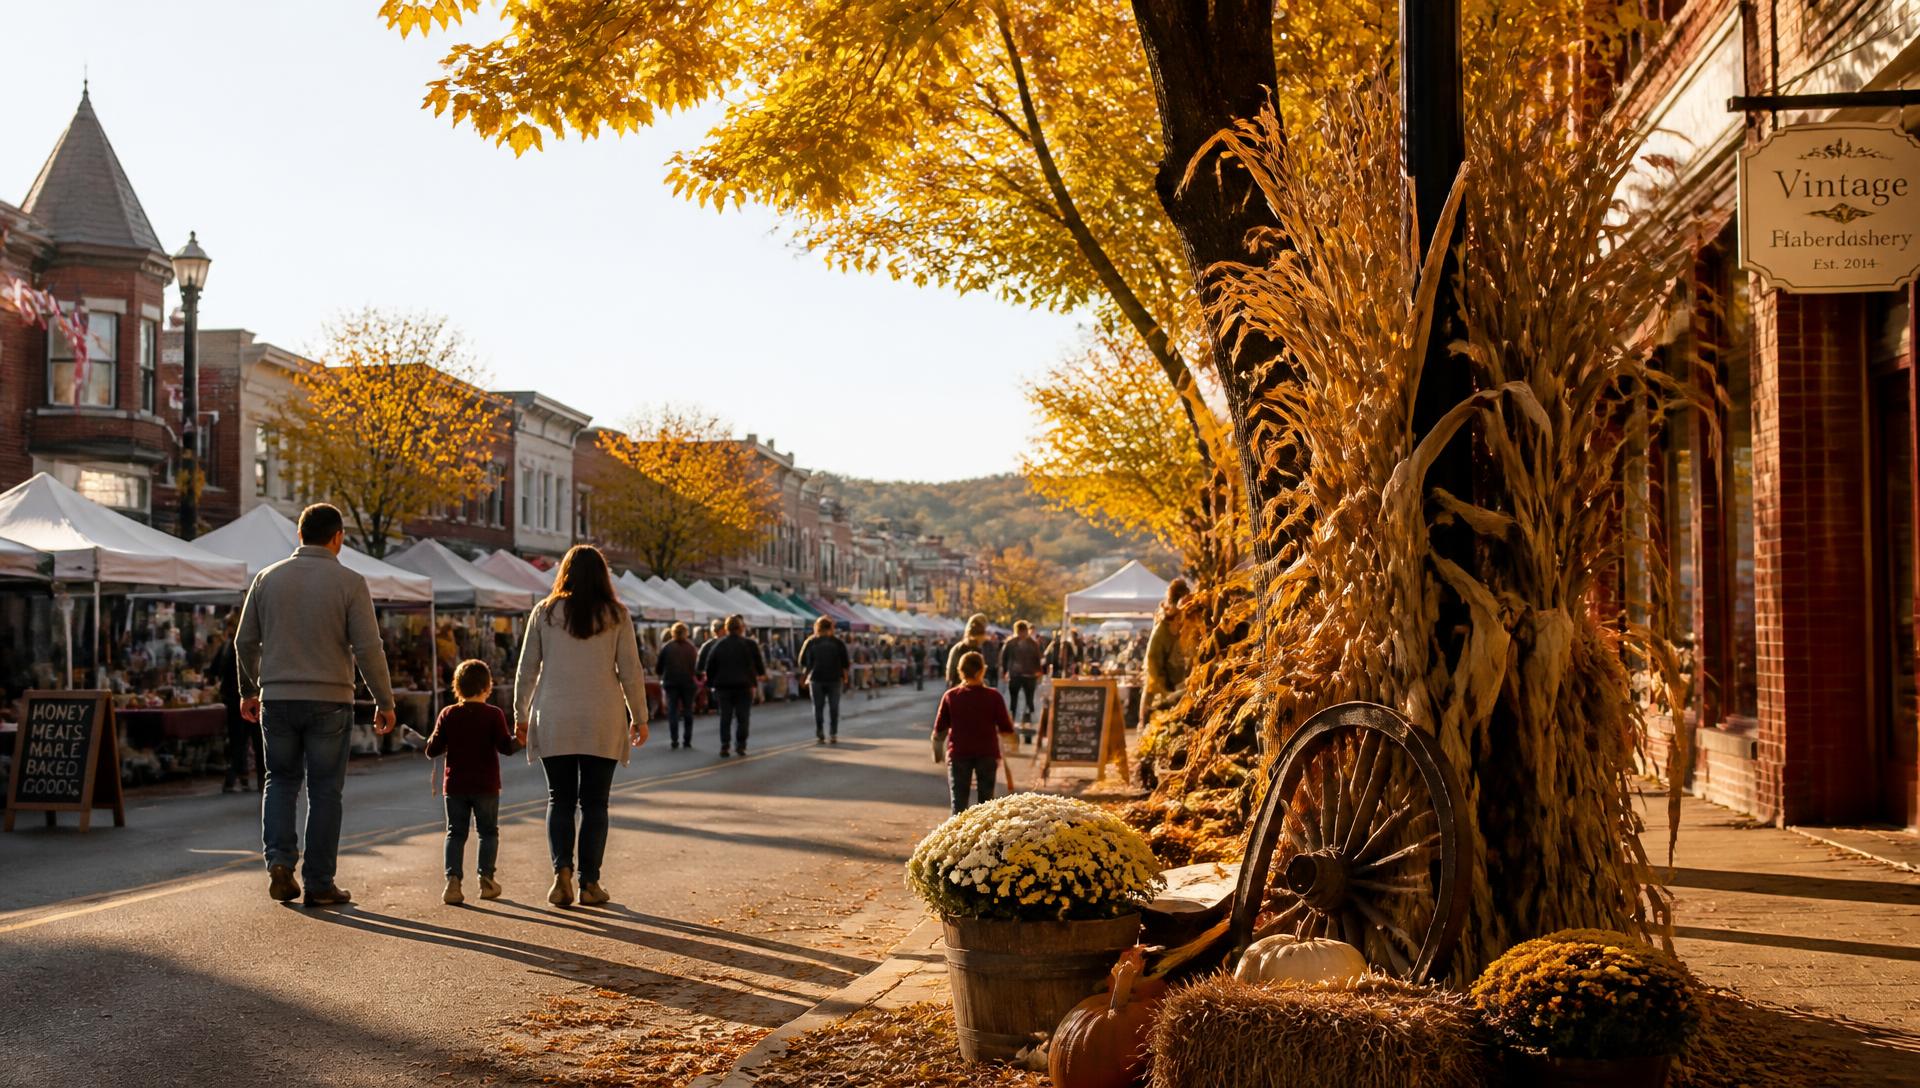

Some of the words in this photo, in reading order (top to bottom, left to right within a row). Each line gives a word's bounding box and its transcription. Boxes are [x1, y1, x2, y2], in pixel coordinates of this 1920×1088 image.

[1773, 169, 1908, 207] Vintage
[1813, 258, 1839, 270] Est.
[33, 704, 89, 720] HONEY
[32, 723, 85, 740] MEATS
[26, 759, 77, 775] BAKED
